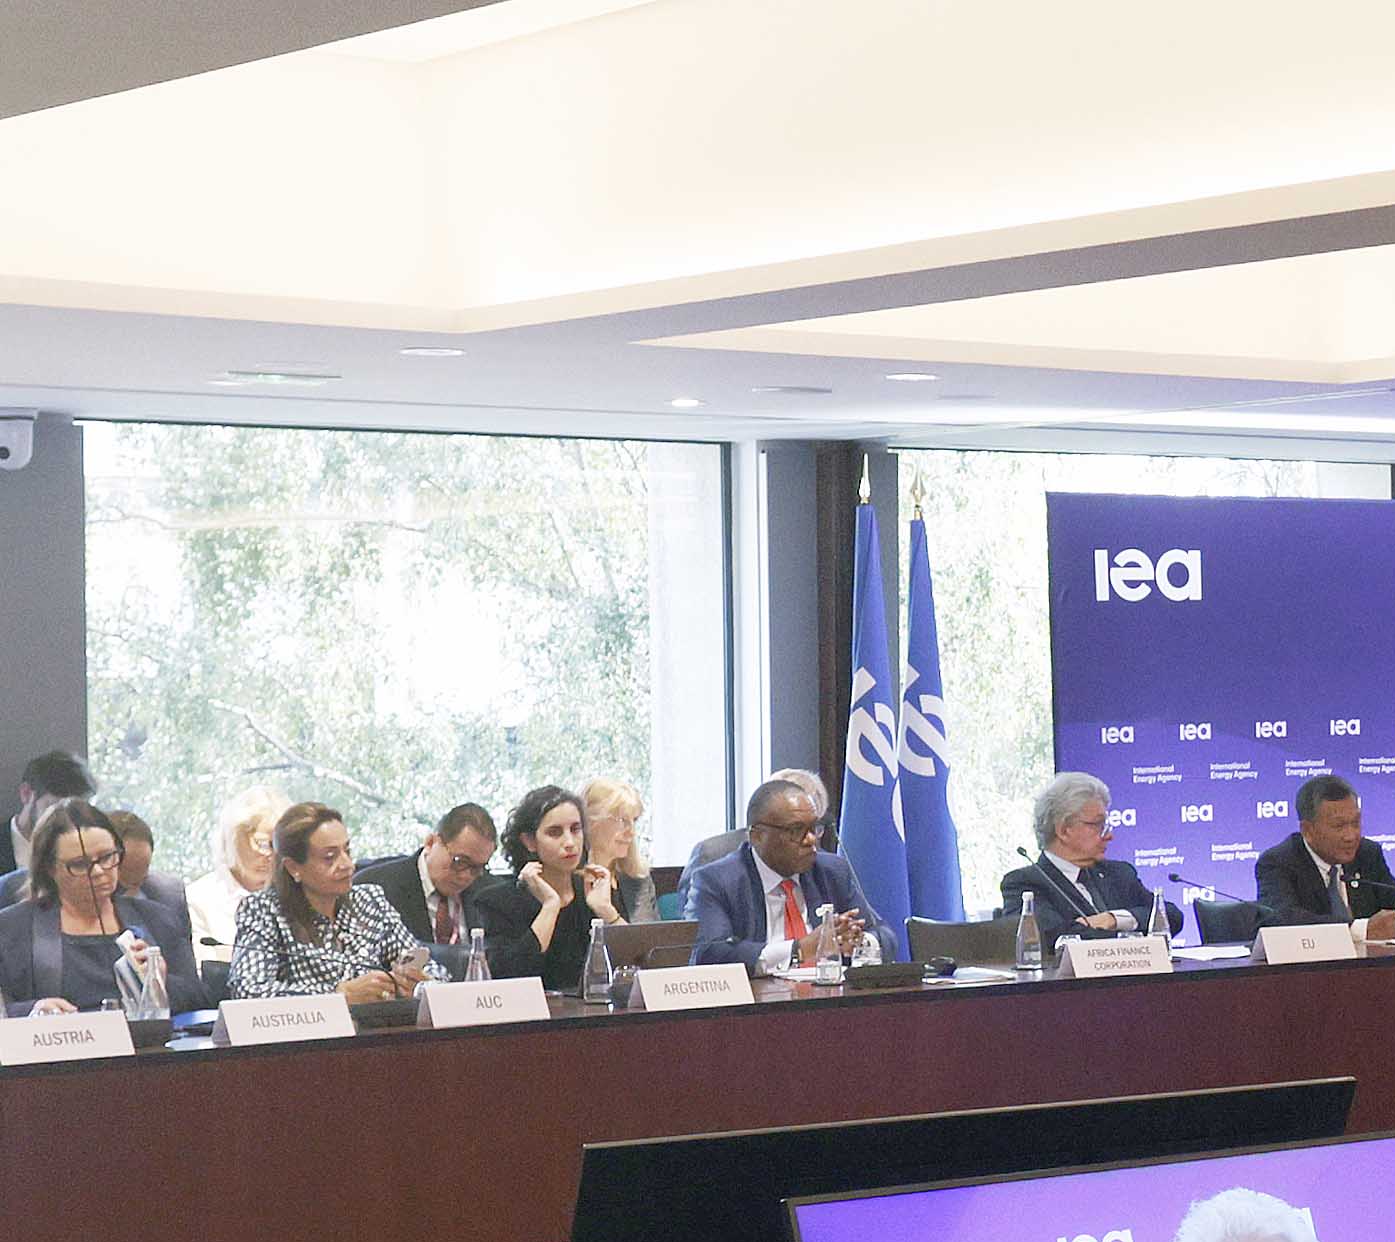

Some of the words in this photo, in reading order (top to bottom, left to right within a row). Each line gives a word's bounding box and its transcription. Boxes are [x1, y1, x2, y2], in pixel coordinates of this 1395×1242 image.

[1093, 548, 1202, 602] iea
[1087, 947, 1116, 957] AFRICA
[1117, 946, 1151, 956] FINANCE
[1301, 939, 1315, 949] EU
[1094, 959, 1152, 970] CORPORATION
[663, 977, 732, 997] ARGENTINA
[475, 994, 504, 1011] AUC
[251, 1009, 326, 1030] AUSTRALIA
[32, 1028, 95, 1047] AUSTRIA
